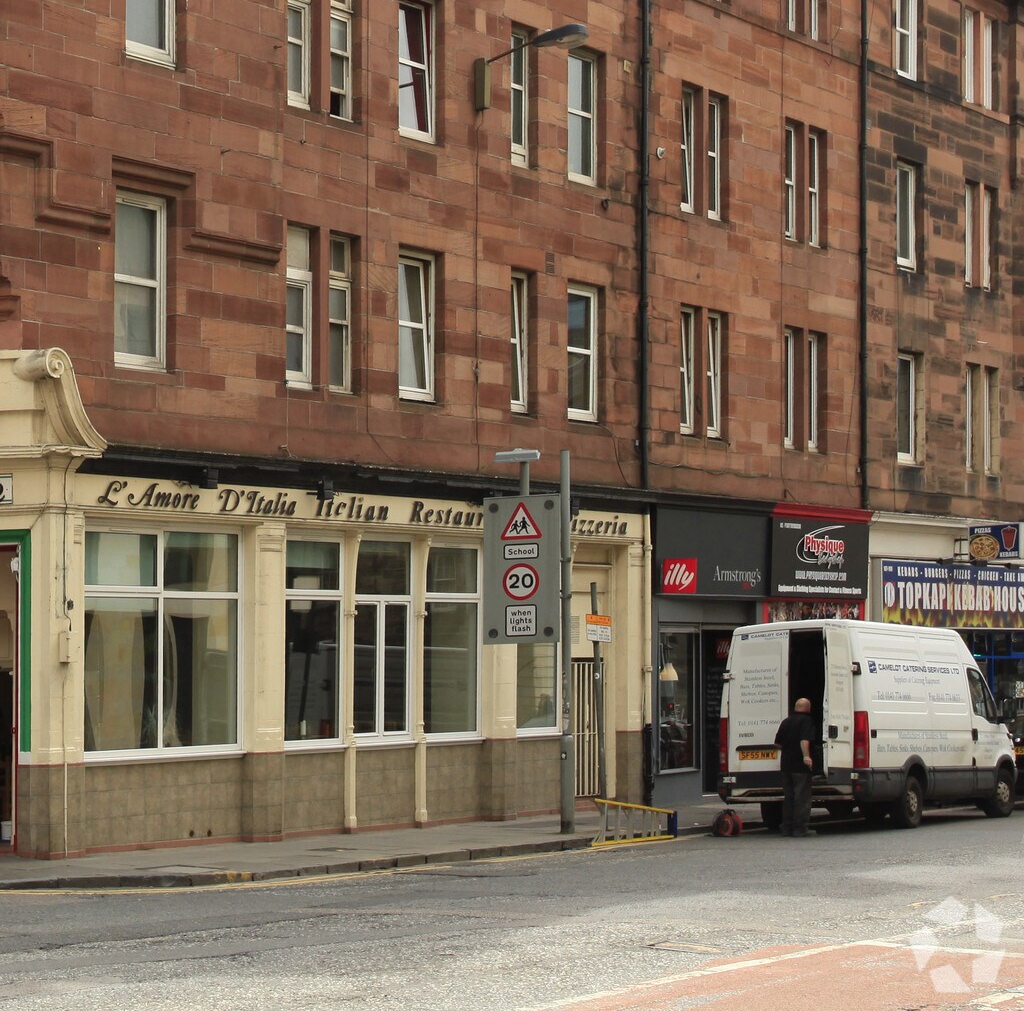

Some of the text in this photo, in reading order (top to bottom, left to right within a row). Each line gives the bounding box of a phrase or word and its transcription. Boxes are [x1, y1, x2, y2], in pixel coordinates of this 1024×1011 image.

[218, 487, 297, 517] D'Italia
[409, 500, 484, 527] Restaur
[571, 514, 628, 536] izzeria
[508, 548, 535, 556] School
[803, 534, 845, 555] Physique
[508, 573, 534, 589] 20
[664, 562, 695, 591] illy
[713, 565, 762, 587] Armstrong's
[897, 566, 919, 577] KEBABS
[924, 567, 948, 579] BURGERS
[953, 569, 971, 580] PIZZAS
[977, 570, 999, 581] CHICKEN
[1003, 572, 1016, 582] TAKE
[954, 583, 991, 611] KEBAB
[509, 617, 532, 625] lights
[877, 663, 960, 675] CAMELOT CATERING SERVICES LTD
[761, 750, 775, 758] NWY
